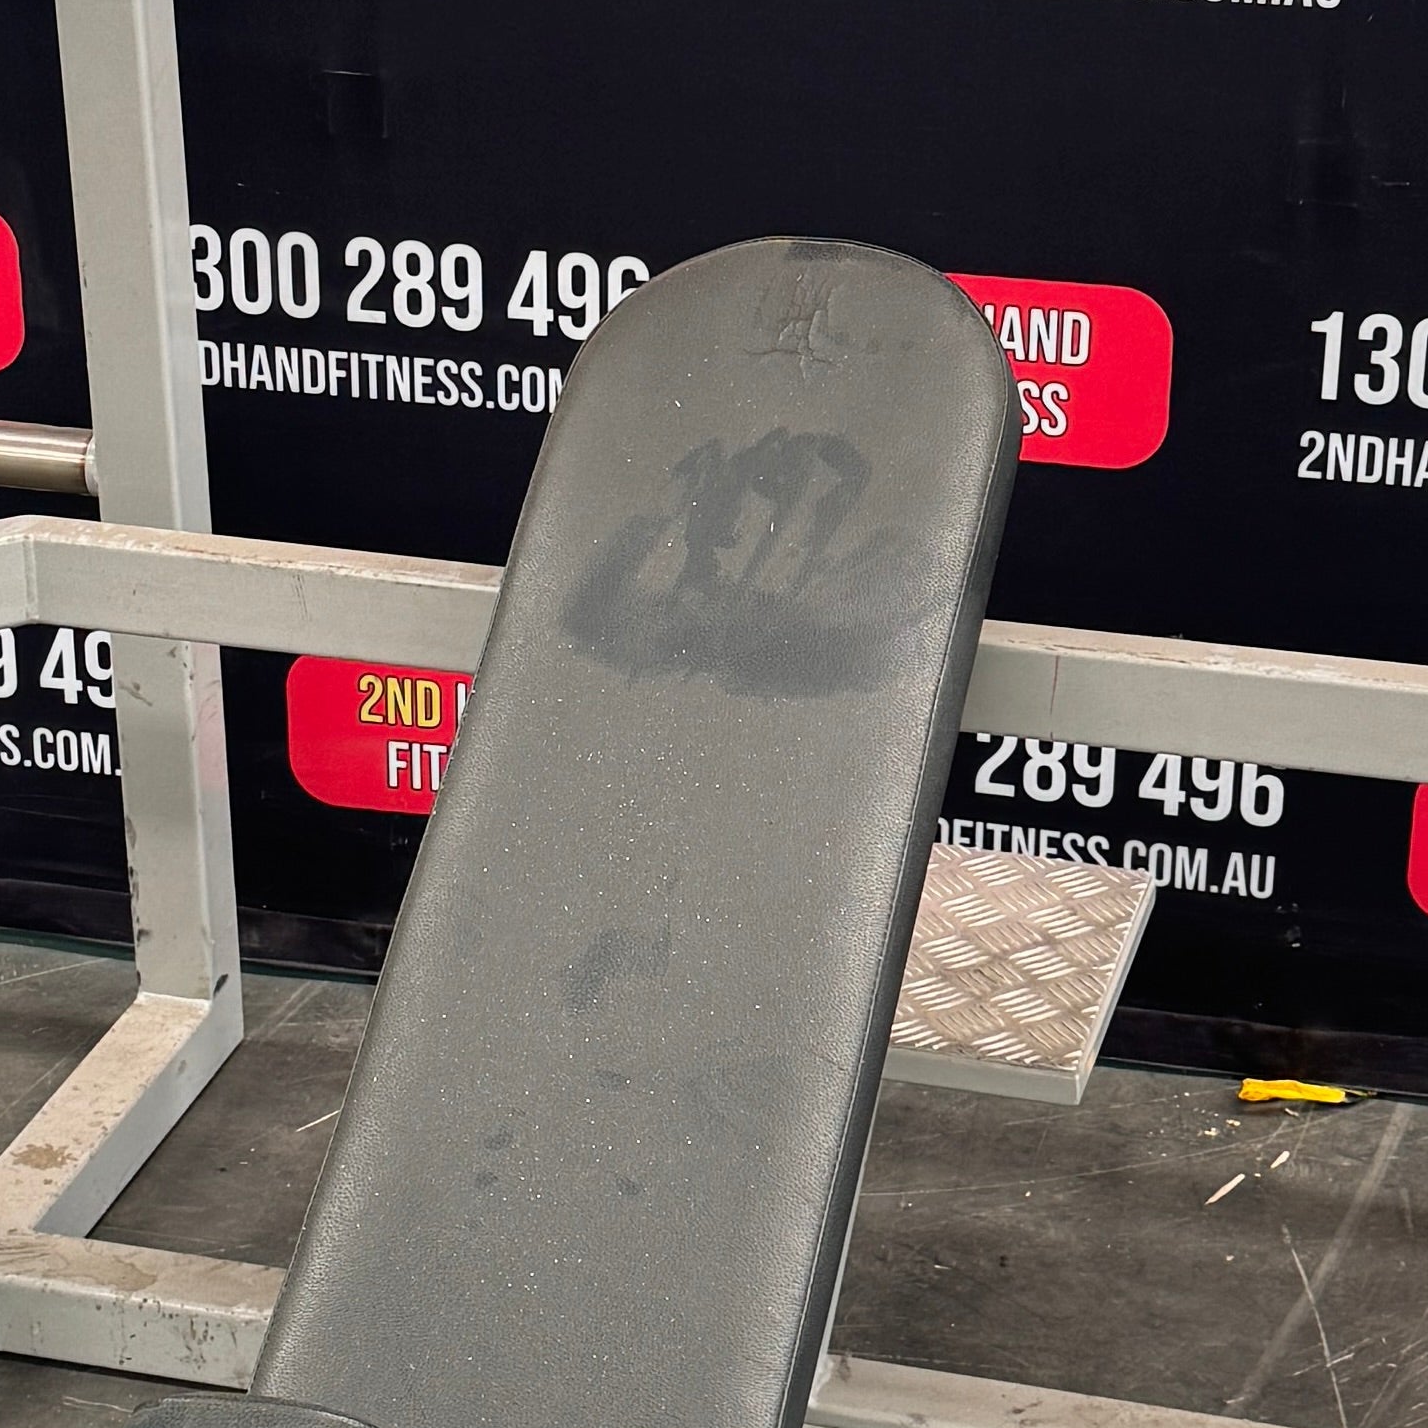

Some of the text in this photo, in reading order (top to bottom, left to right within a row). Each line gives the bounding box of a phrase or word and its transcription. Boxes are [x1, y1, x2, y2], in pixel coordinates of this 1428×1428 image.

[189, 222, 322, 320] 300
[343, 235, 484, 333] 289
[39, 627, 117, 709] 49
[358, 673, 442, 728] 2ND
